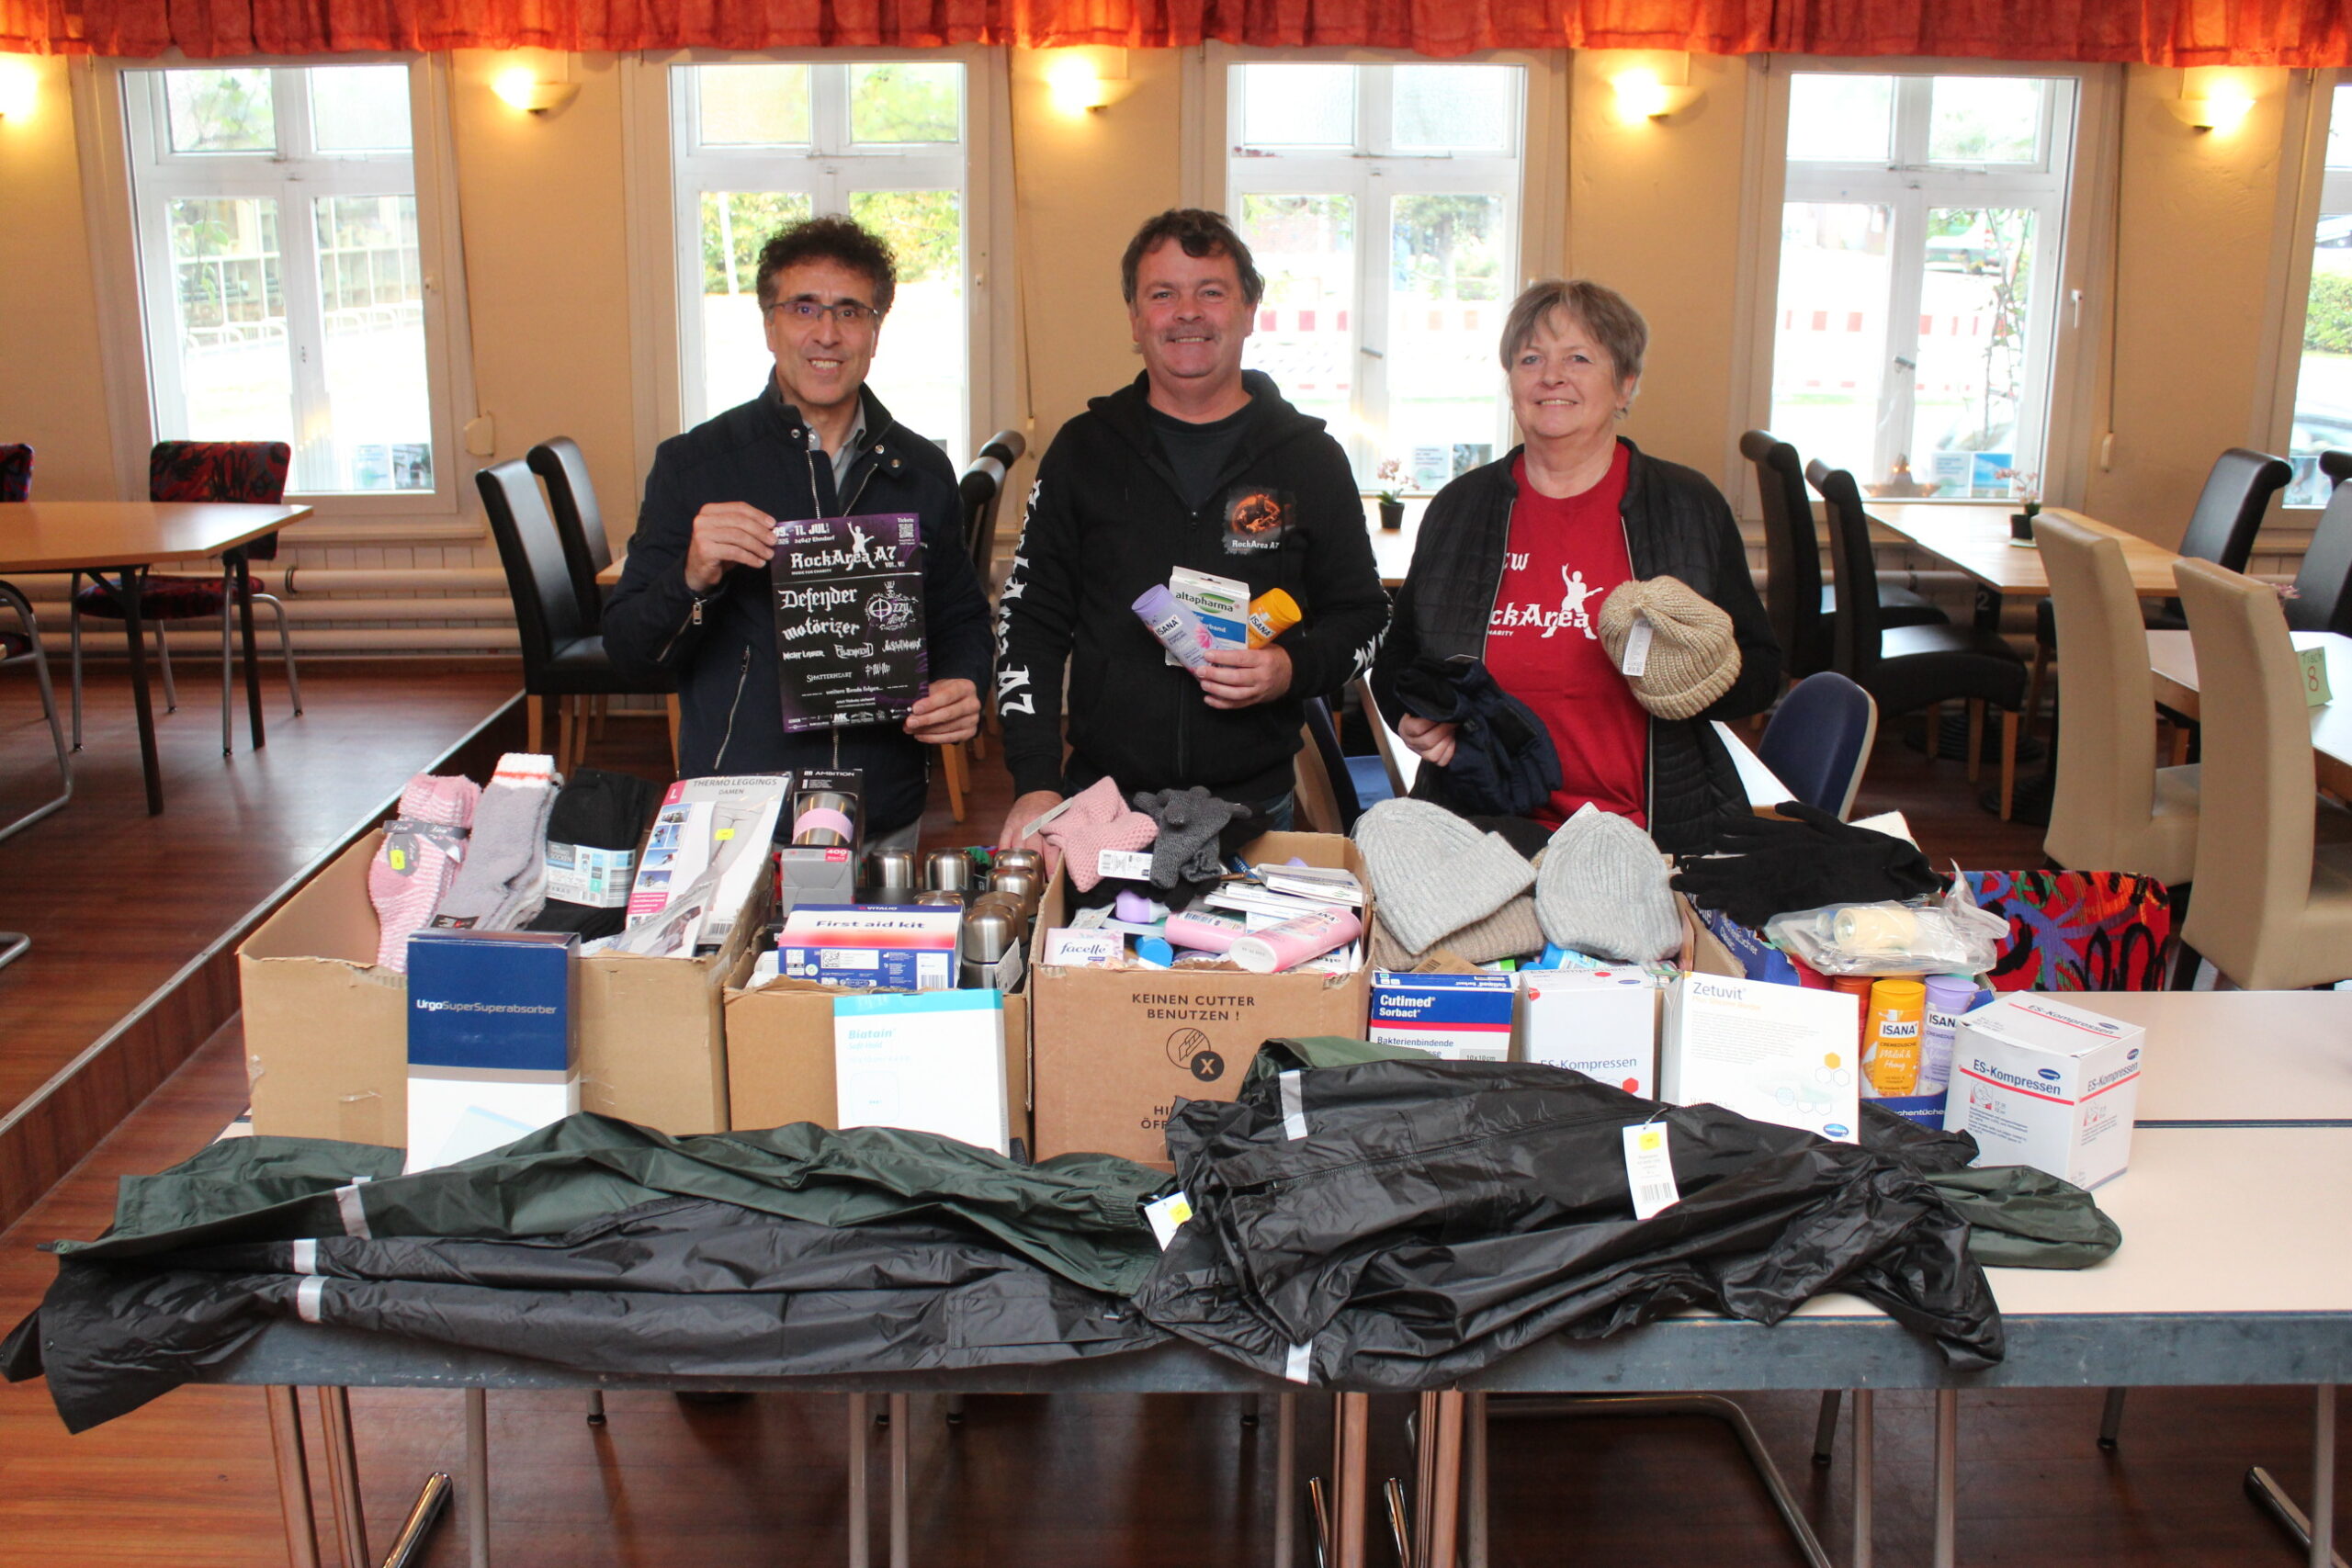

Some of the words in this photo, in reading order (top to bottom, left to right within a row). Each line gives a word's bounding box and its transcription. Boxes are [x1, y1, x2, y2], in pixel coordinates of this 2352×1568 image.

[1232, 539, 1269, 549] RockArea
[790, 549, 869, 569] RockArea
[874, 546, 897, 562] A7
[777, 586, 857, 613] Defender
[1175, 591, 1234, 613] altapharma
[782, 616, 860, 640] motörizer
[1155, 617, 1180, 637] ISANA
[1250, 615, 1272, 637] ISANA
[2301, 650, 2323, 664] Tisch
[2307, 666, 2319, 692] 8
[997, 662, 1035, 717] A7
[693, 779, 729, 787] THERMO
[731, 778, 777, 786] LEGGINGS
[670, 788, 677, 799] L
[865, 920, 893, 929] aid
[1059, 942, 1106, 955] facelle
[1692, 982, 1743, 1000] Zetuvit
[416, 998, 557, 1015] UrgoSuperSuperabsorber
[1132, 994, 1189, 1005] KEINEN
[1195, 996, 1255, 1007] CUTTER
[1380, 994, 1431, 1008] Cutimed
[1148, 1010, 1229, 1021] BENUTZEN
[1379, 1007, 1418, 1018] Sorbact
[2027, 1005, 2114, 1035] ES-Kompressen
[848, 1030, 894, 1040] Biatain
[1883, 1025, 1916, 1035] ISANA
[1377, 1036, 1453, 1047] Bakterienbindende
[1879, 1048, 1905, 1060] Milch
[1540, 1058, 1637, 1072] ES-Kompressen
[1973, 1059, 2061, 1095] ES-Kompressen
[2087, 1061, 2139, 1092] ES-Kompressen
[1154, 1106, 1173, 1115] HI
